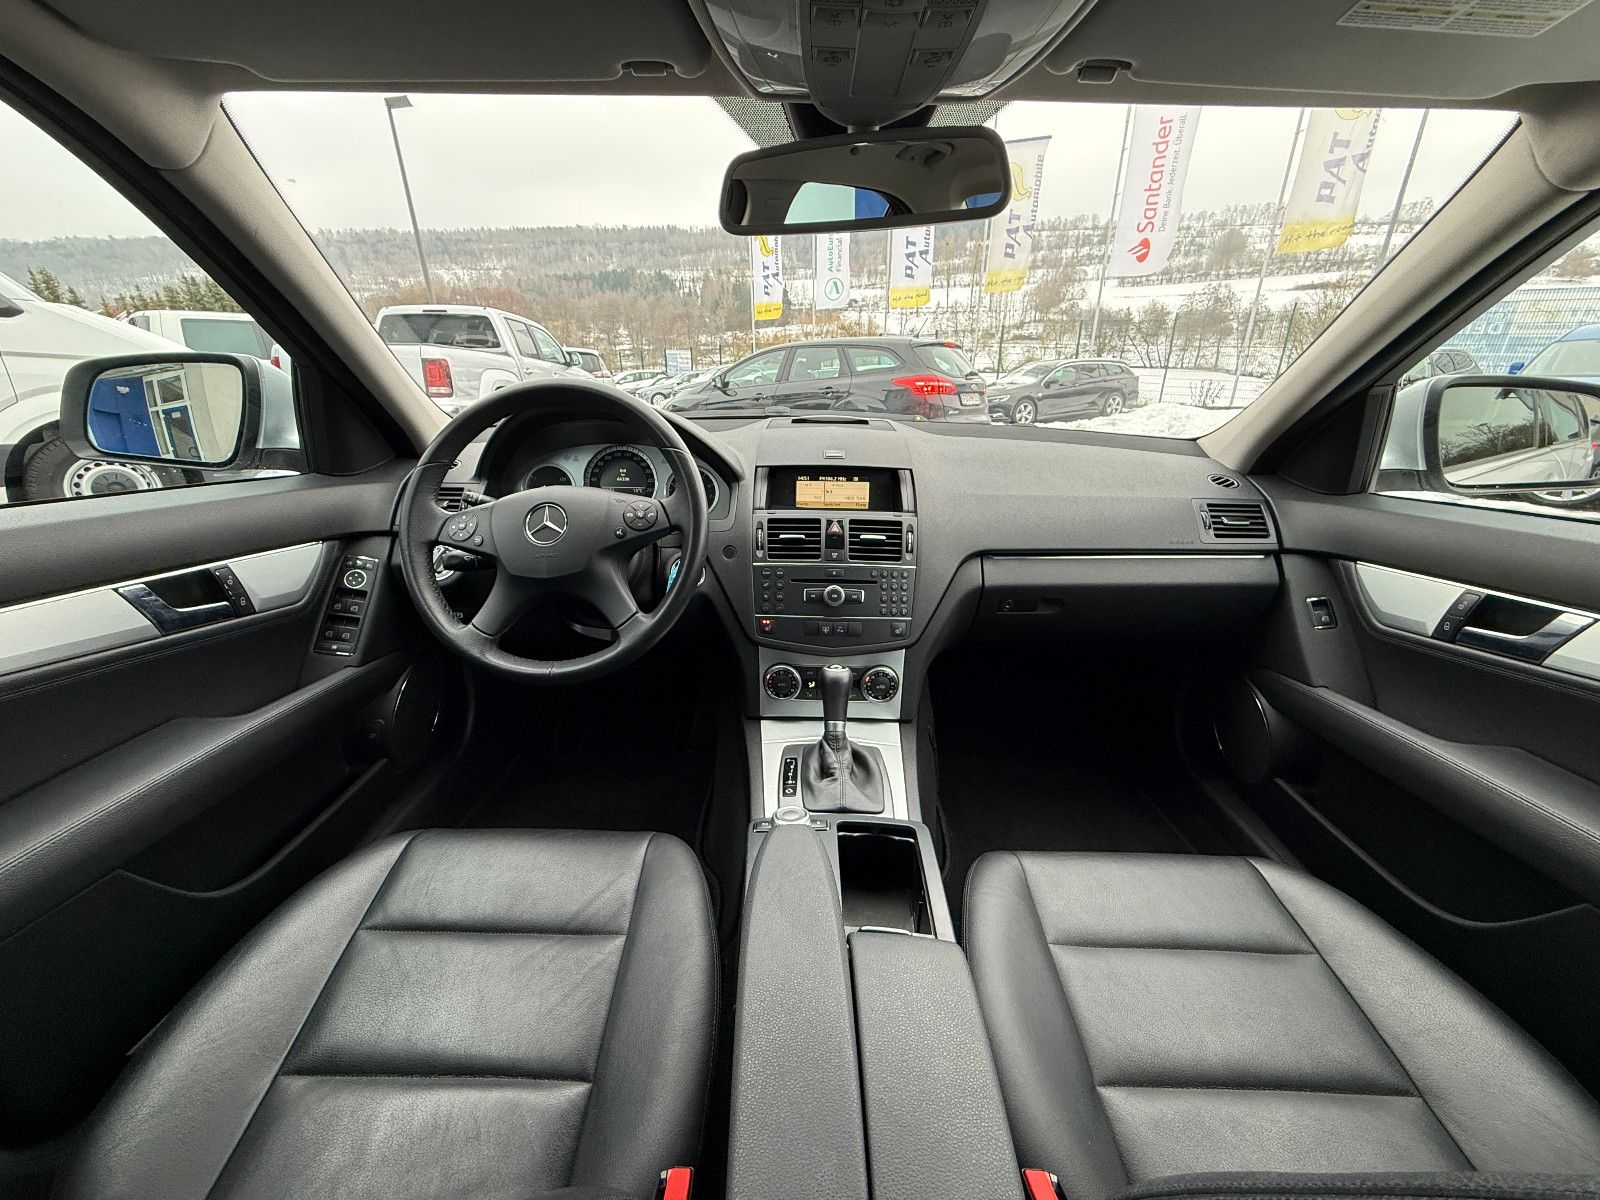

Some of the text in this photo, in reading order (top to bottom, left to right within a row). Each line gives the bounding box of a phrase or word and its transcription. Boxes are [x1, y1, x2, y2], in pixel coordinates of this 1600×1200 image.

[1137, 116, 1174, 233] Santander
[1315, 131, 1352, 204] PAT
[1023, 154, 1044, 239] Automobile
[1163, 189, 1172, 209] Bank
[1004, 209, 1021, 259] PAT
[1158, 210, 1169, 232] Deine
[771, 237, 783, 286] Automob
[835, 237, 843, 272] Financial
[904, 235, 919, 279] PAT
[919, 226, 932, 266] Auto
[762, 261, 773, 296] PAT
